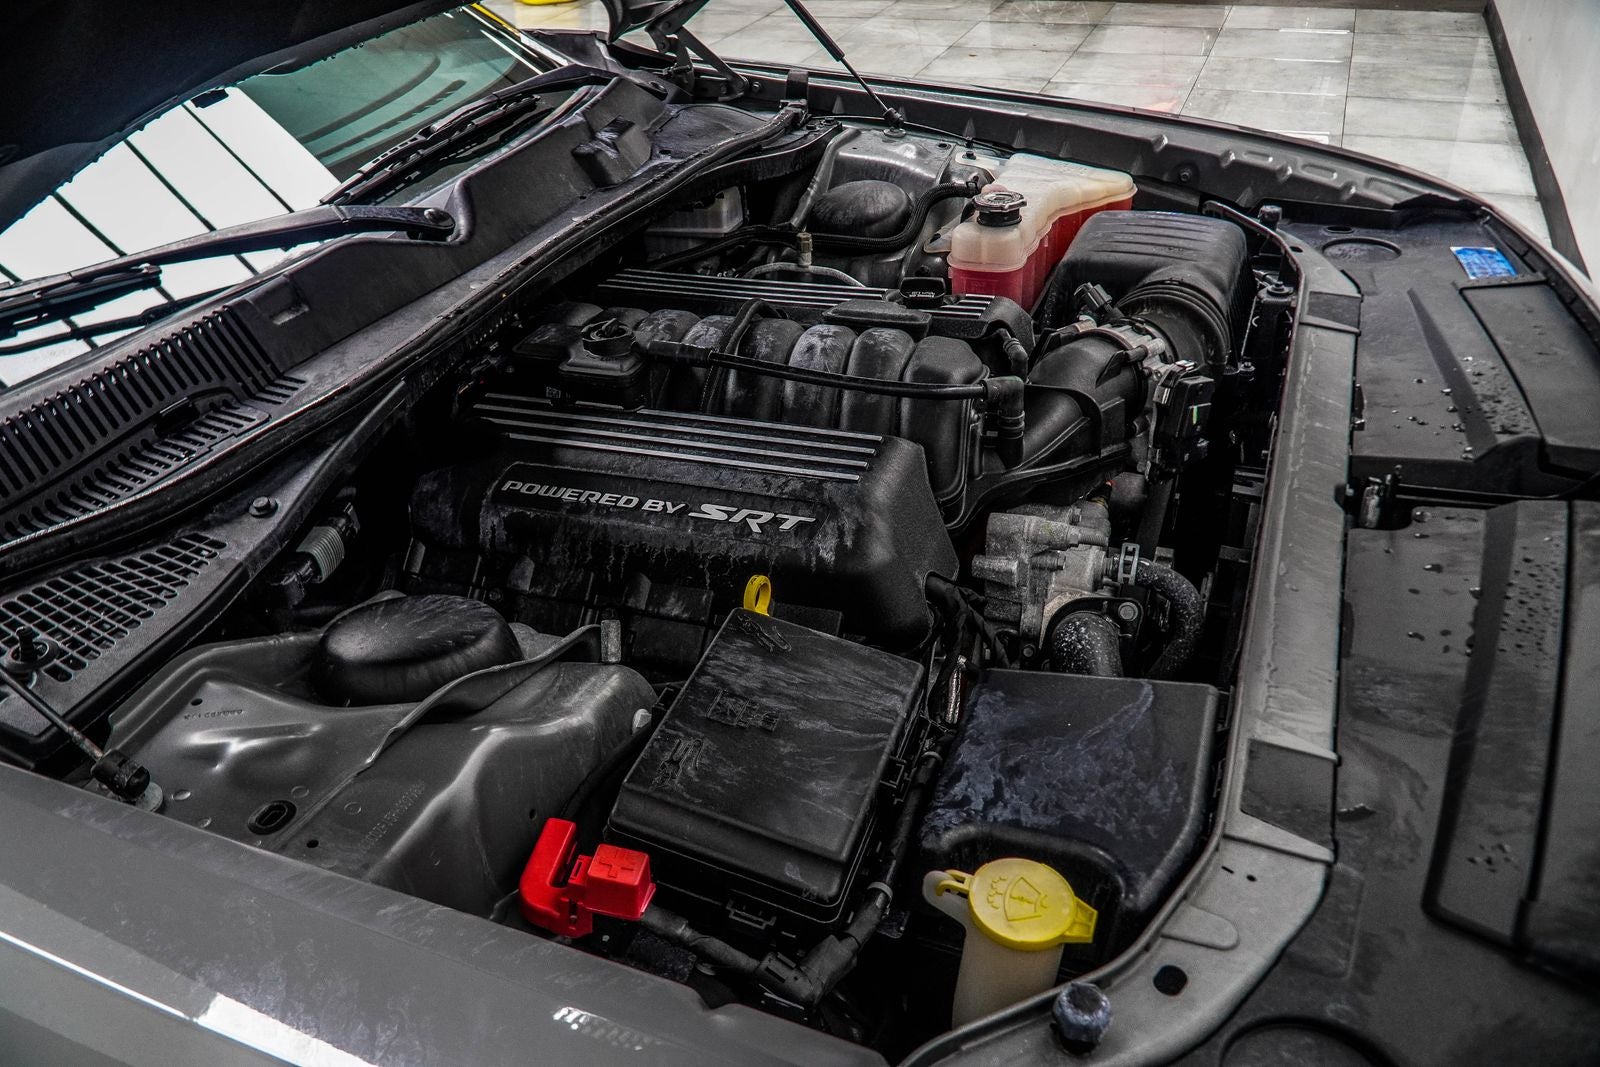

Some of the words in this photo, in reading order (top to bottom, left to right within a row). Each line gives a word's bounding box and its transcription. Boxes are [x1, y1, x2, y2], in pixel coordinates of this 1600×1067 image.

[501, 479, 640, 509] POWERED
[641, 499, 686, 515] BY
[688, 503, 817, 534] SRT
